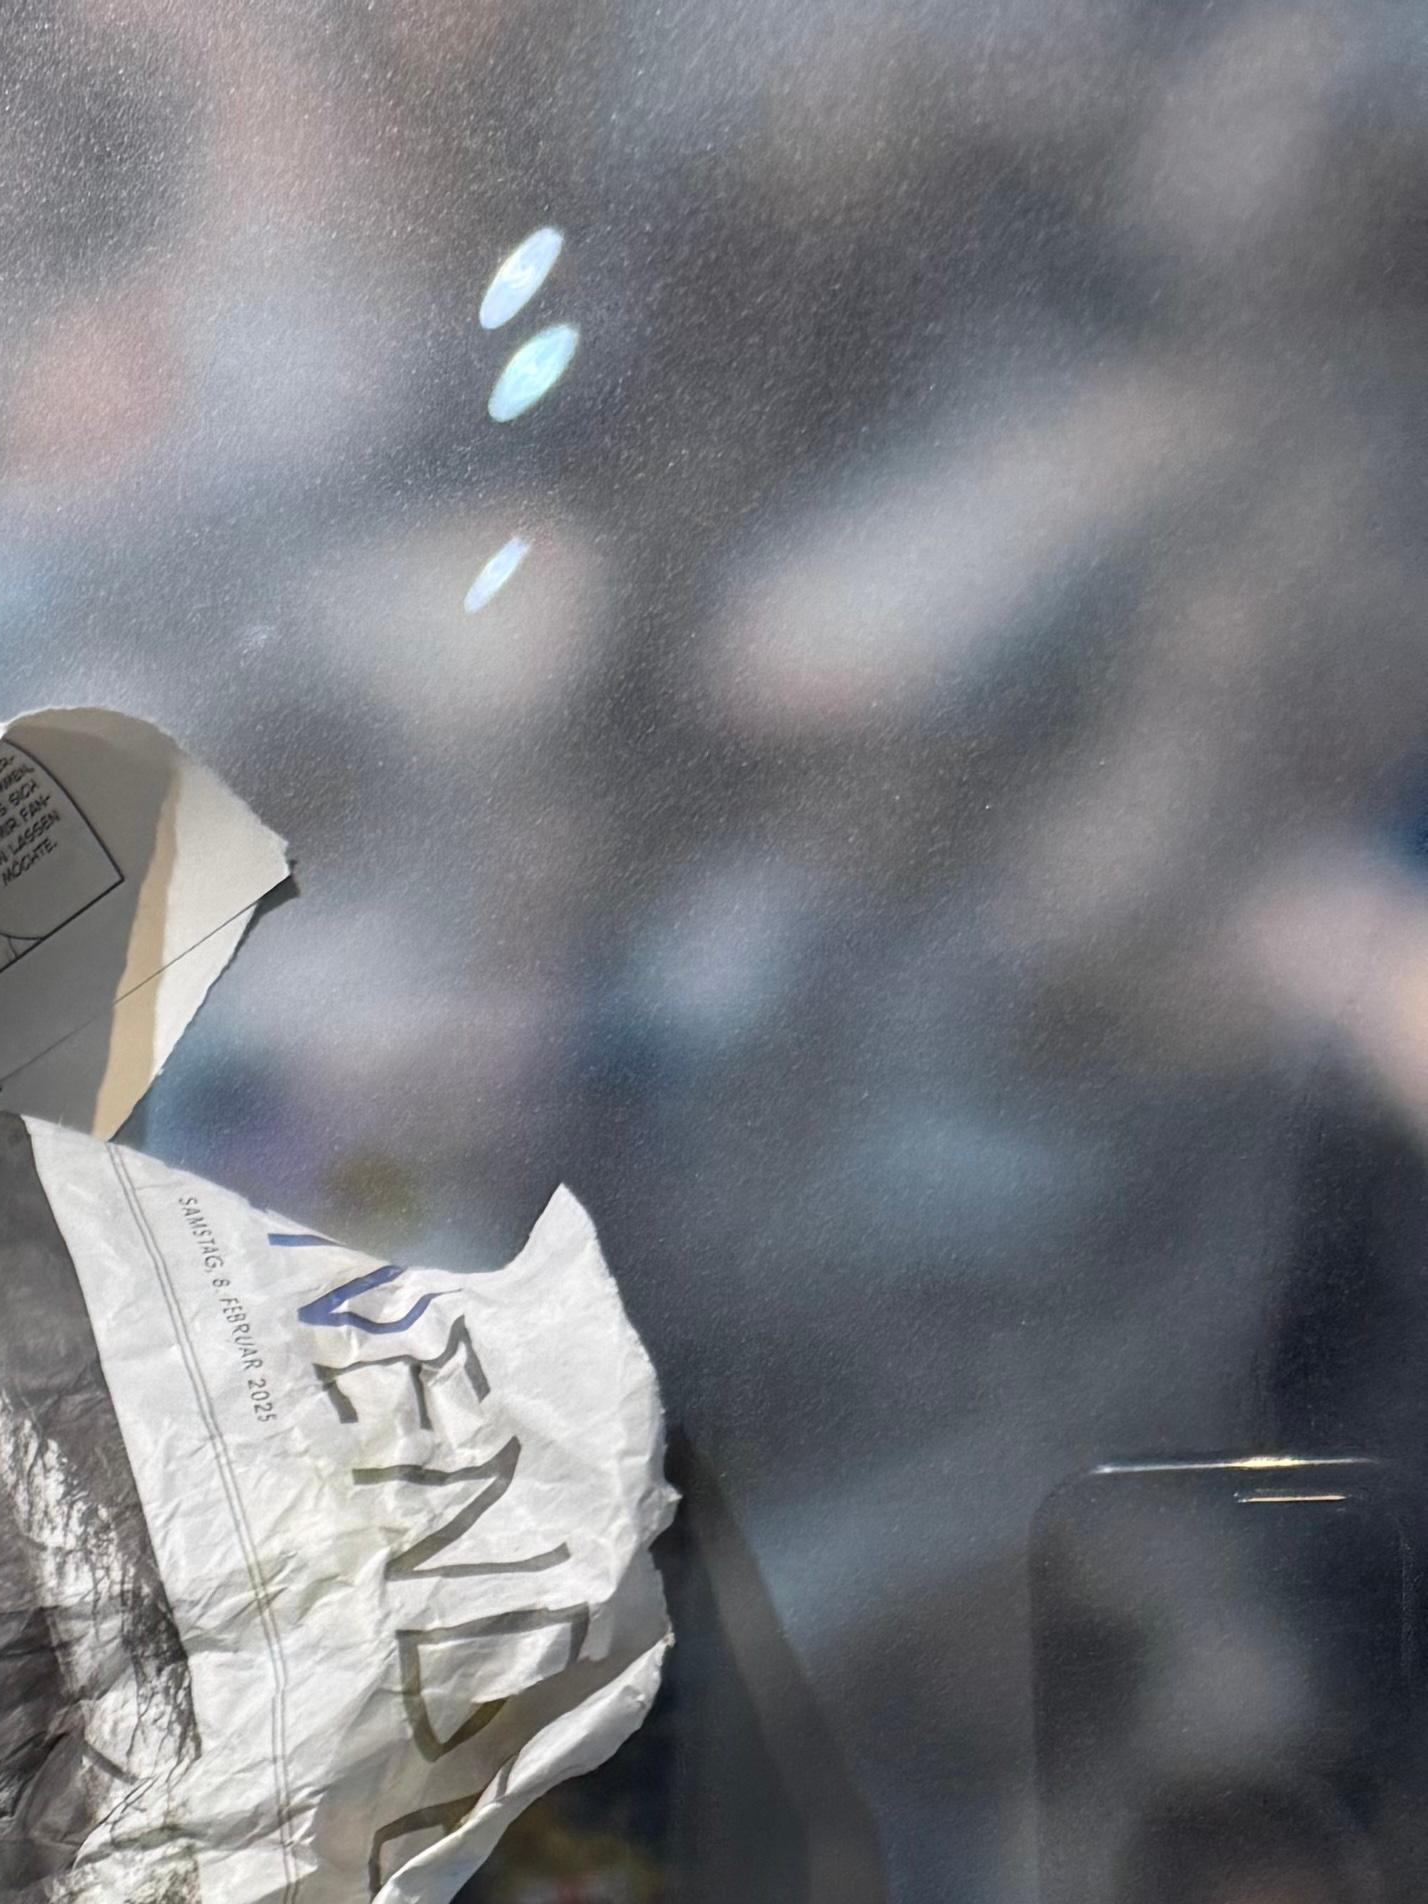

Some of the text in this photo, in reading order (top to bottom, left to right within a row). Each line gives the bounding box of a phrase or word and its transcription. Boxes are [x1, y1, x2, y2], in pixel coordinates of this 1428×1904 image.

[7, 809, 62, 856] LASSEN
[218, 1296, 265, 1372] FEBRUAR
[246, 1376, 278, 1423] 2025
